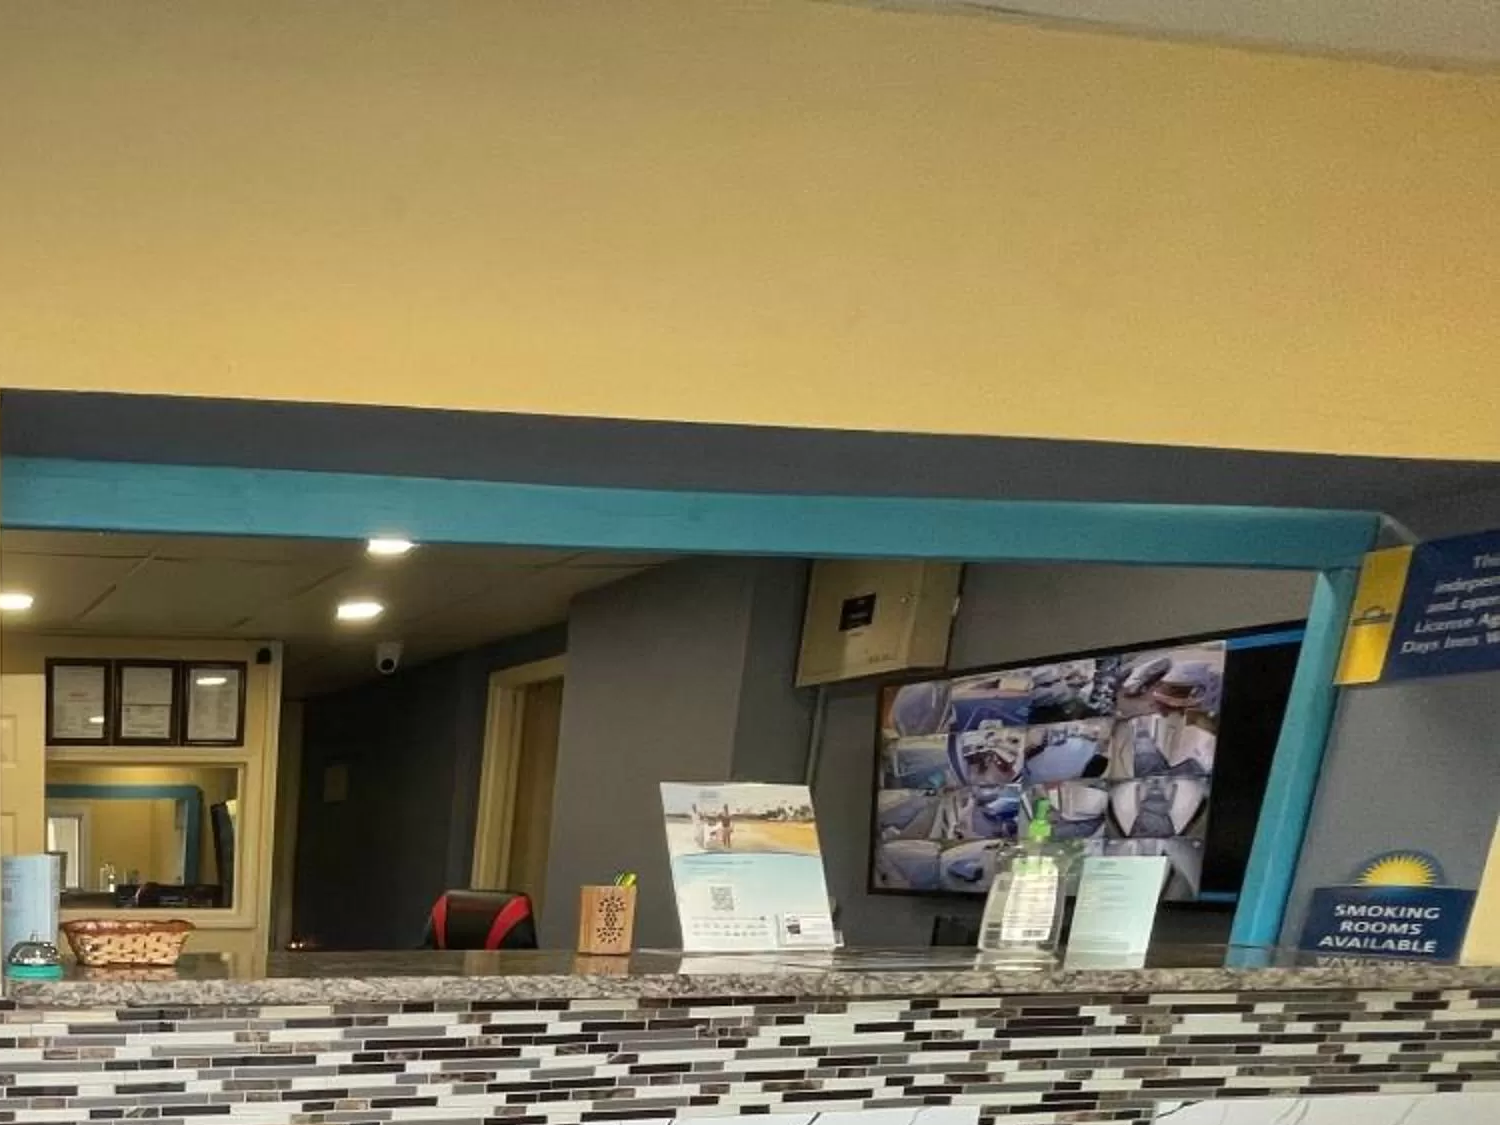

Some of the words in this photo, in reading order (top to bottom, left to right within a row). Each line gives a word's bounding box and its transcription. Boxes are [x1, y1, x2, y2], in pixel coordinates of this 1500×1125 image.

[1400, 640, 1440, 655] Days
[1333, 904, 1442, 920] SMOKING
[1339, 919, 1424, 936] ROOMS
[1317, 935, 1438, 953] AVAILABLE
